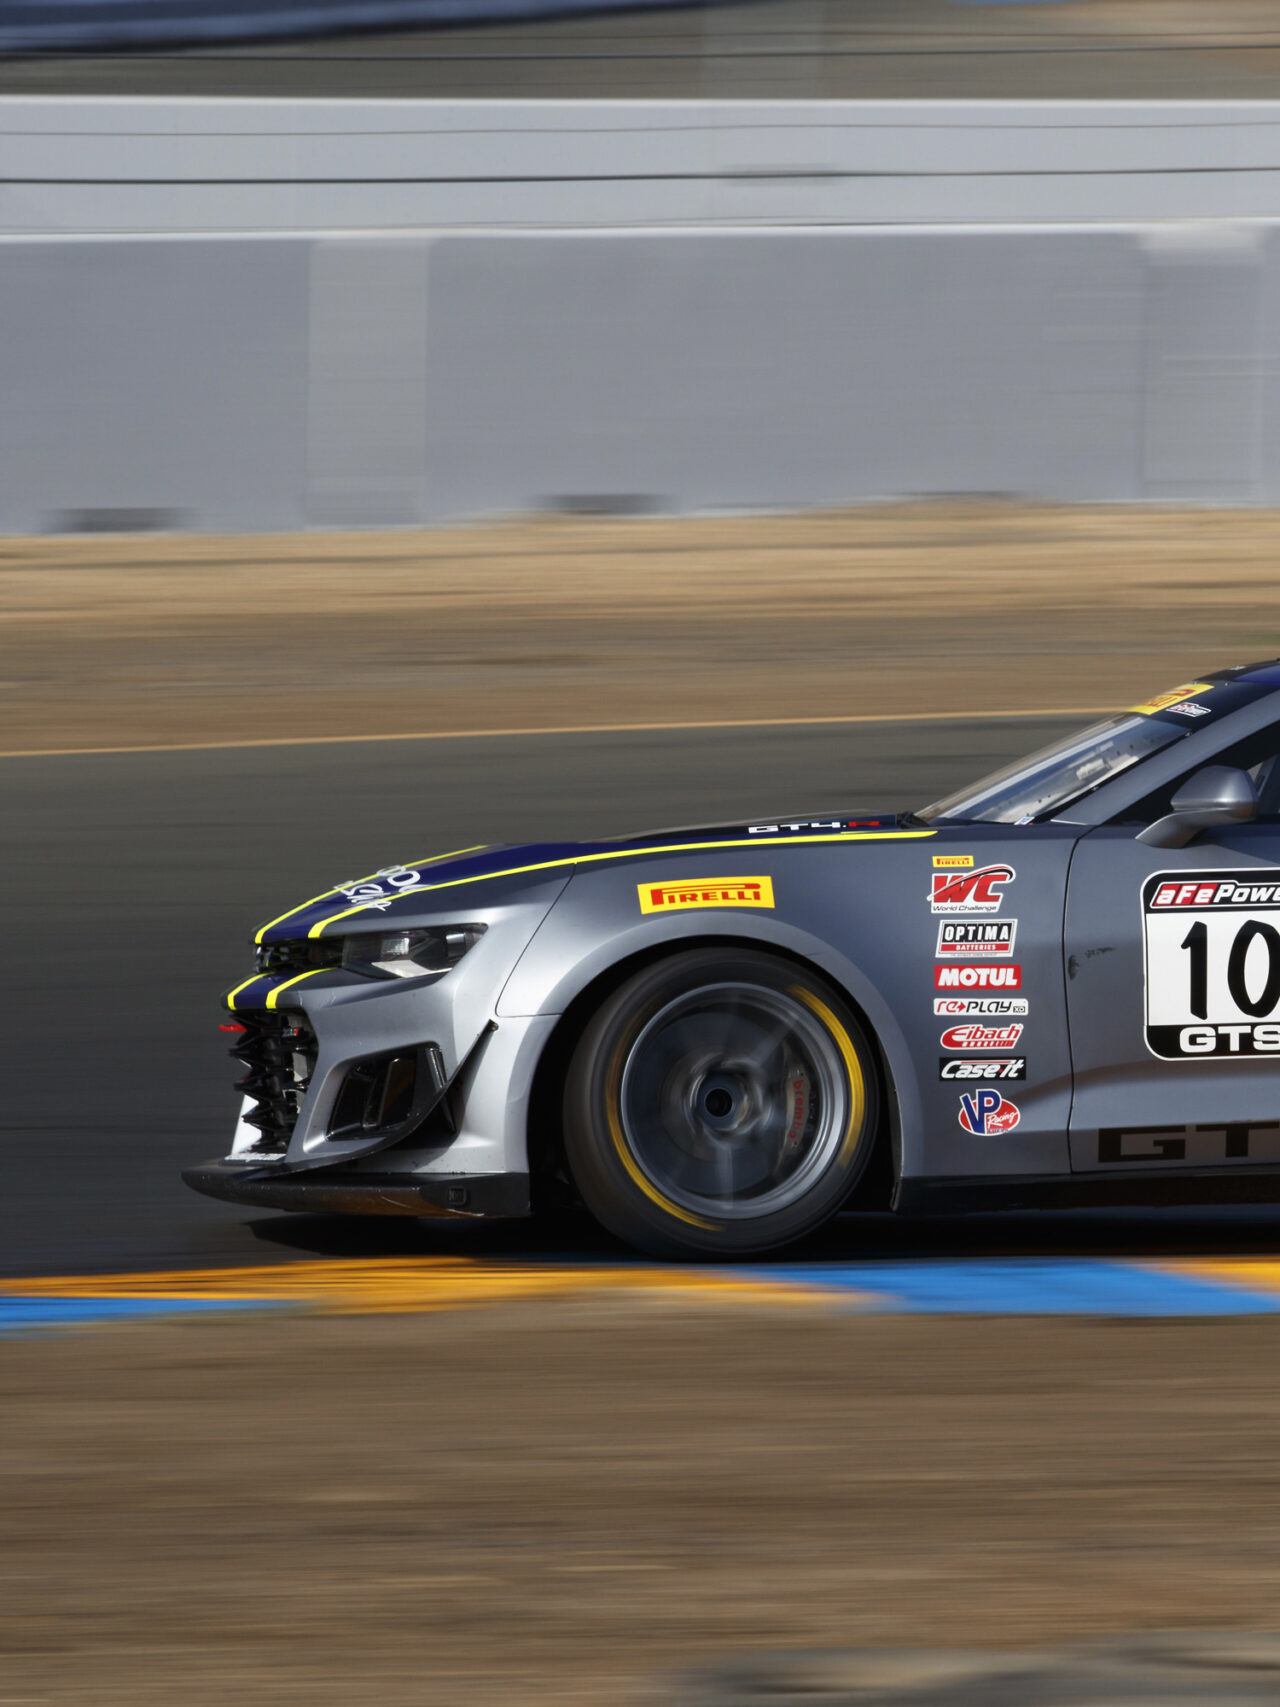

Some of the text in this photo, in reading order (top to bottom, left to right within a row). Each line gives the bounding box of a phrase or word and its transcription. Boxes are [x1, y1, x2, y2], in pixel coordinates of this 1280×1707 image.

[650, 883, 761, 906] PIRELLI
[933, 873, 1009, 903] WC
[959, 905, 998, 913] Challenge
[944, 925, 1010, 942] OPTIMA
[956, 944, 997, 952] BATTERIES
[938, 967, 1018, 987] MOTUL
[941, 1025, 1021, 1048] Eibach
[960, 1089, 1002, 1136] VP
[986, 1111, 1019, 1130] Racing
